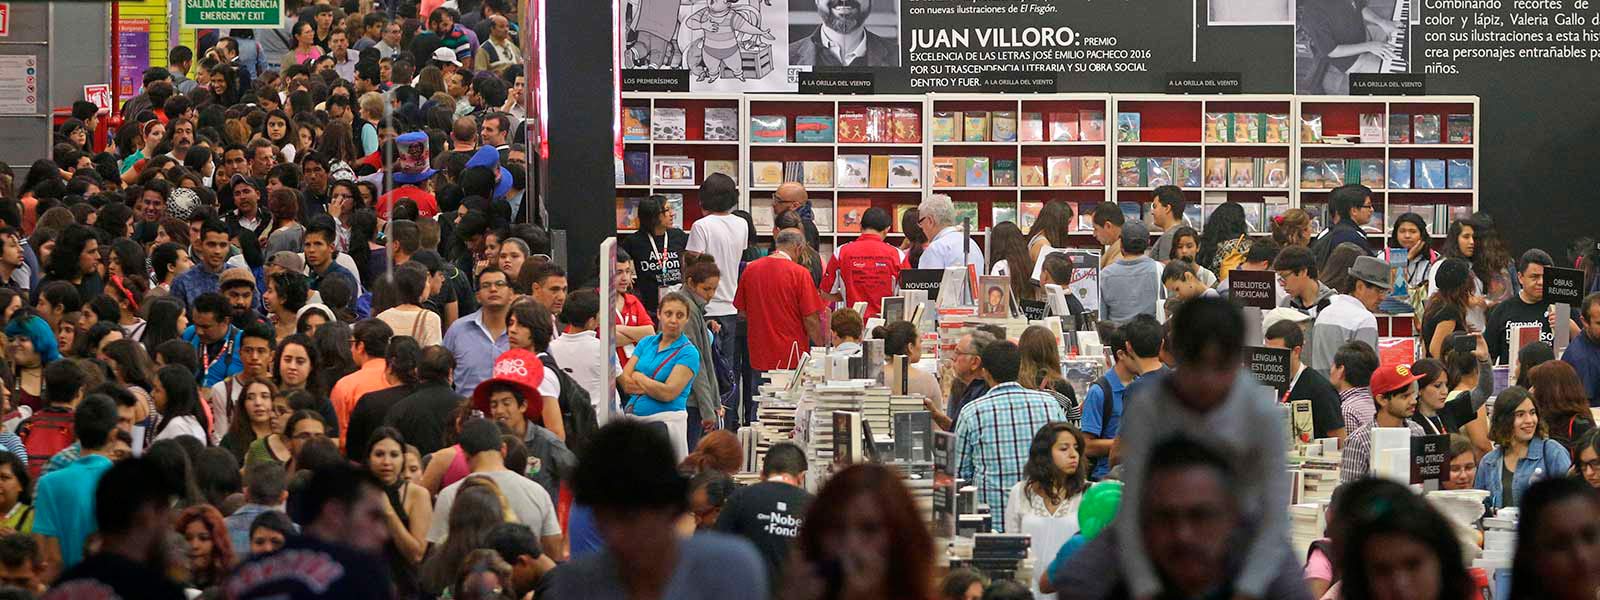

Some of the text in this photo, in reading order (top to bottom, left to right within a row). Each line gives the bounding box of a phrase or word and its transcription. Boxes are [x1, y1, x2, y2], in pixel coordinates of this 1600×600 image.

[187, 0, 278, 8] SALIDA DE EMERGENCIA
[1425, 0, 1589, 9] Combinando recortes de
[200, 11, 264, 20] EMERGENCY EXIT
[957, 5, 1006, 14] ilustraciones
[1008, 5, 1018, 13] de
[1020, 4, 1028, 13] El
[1029, 4, 1058, 16] Fisgón.
[1425, 13, 1600, 29] color y lápiz, Valeria Gallo d
[909, 27, 1117, 52] JUAN VILLORO: PREMIO
[1425, 29, 1600, 42] con sus ilustraciones a esta his
[910, 49, 1151, 61] EXCELENCIA DE LAS LETRAS JOSÉ EMILIO PACHECO 2016
[1425, 47, 1449, 58] crea
[1453, 47, 1515, 61] personajes
[1518, 45, 1587, 58] entrañables
[910, 65, 929, 74] POR
[930, 65, 942, 74] SU
[945, 64, 1020, 74] TRASCENDENCIA
[1067, 63, 1073, 72] Y
[1075, 63, 1087, 72] SU
[1088, 63, 1113, 72] OBRA
[1114, 62, 1148, 72] SOCIAL
[1425, 62, 1460, 74] niños.
[910, 78, 949, 87] DENTRO
[950, 78, 957, 87] Y
[649, 251, 679, 262] Anus
[640, 260, 680, 271] Deaon
[1232, 281, 1271, 290] BIBLIOTECA
[1553, 279, 1574, 287] OBRAS
[1235, 290, 1269, 298] MEXICANA
[1548, 287, 1578, 297] REUNIDAS
[1505, 320, 1543, 328] Fernando
[1252, 353, 1283, 364] LENGUA Y
[1251, 363, 1284, 373] ESTUDIOS
[1252, 372, 1286, 383] TERARIOS
[1424, 443, 1436, 452] FCE
[1416, 454, 1445, 464] EN OTROS
[1420, 464, 1440, 474] PAÍSES
[771, 512, 803, 527] Nobe
[770, 523, 801, 537] Fond
